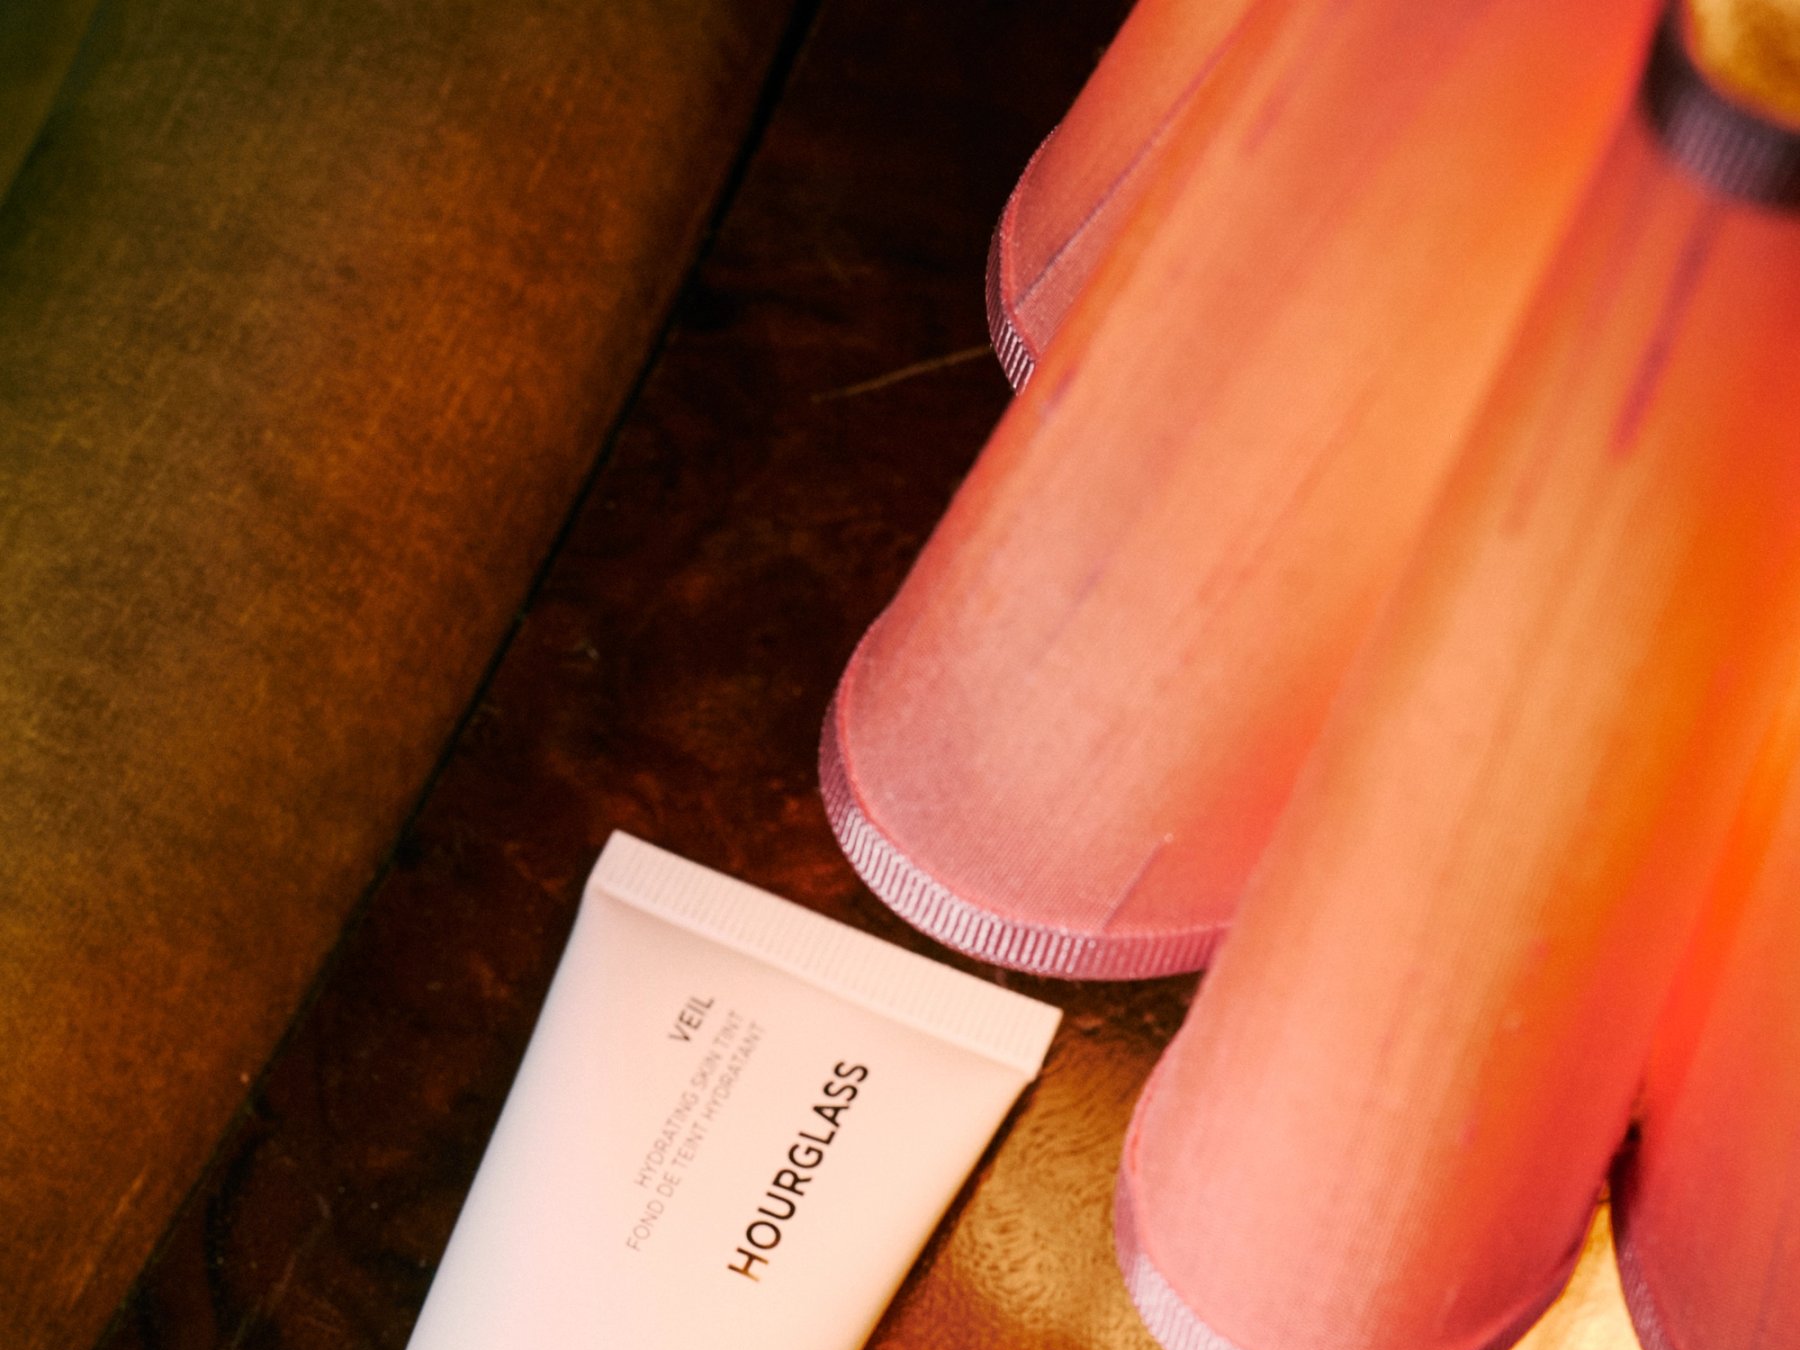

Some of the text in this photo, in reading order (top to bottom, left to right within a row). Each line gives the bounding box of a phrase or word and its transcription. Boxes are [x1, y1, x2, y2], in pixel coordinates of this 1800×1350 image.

[634, 1009, 745, 1189] HYDRATING SKIN TINT
[668, 995, 715, 1043] VEIL
[626, 1019, 766, 1252] FOND DE TEINT HYDRATANT
[727, 1061, 869, 1282] HOURGLASS
